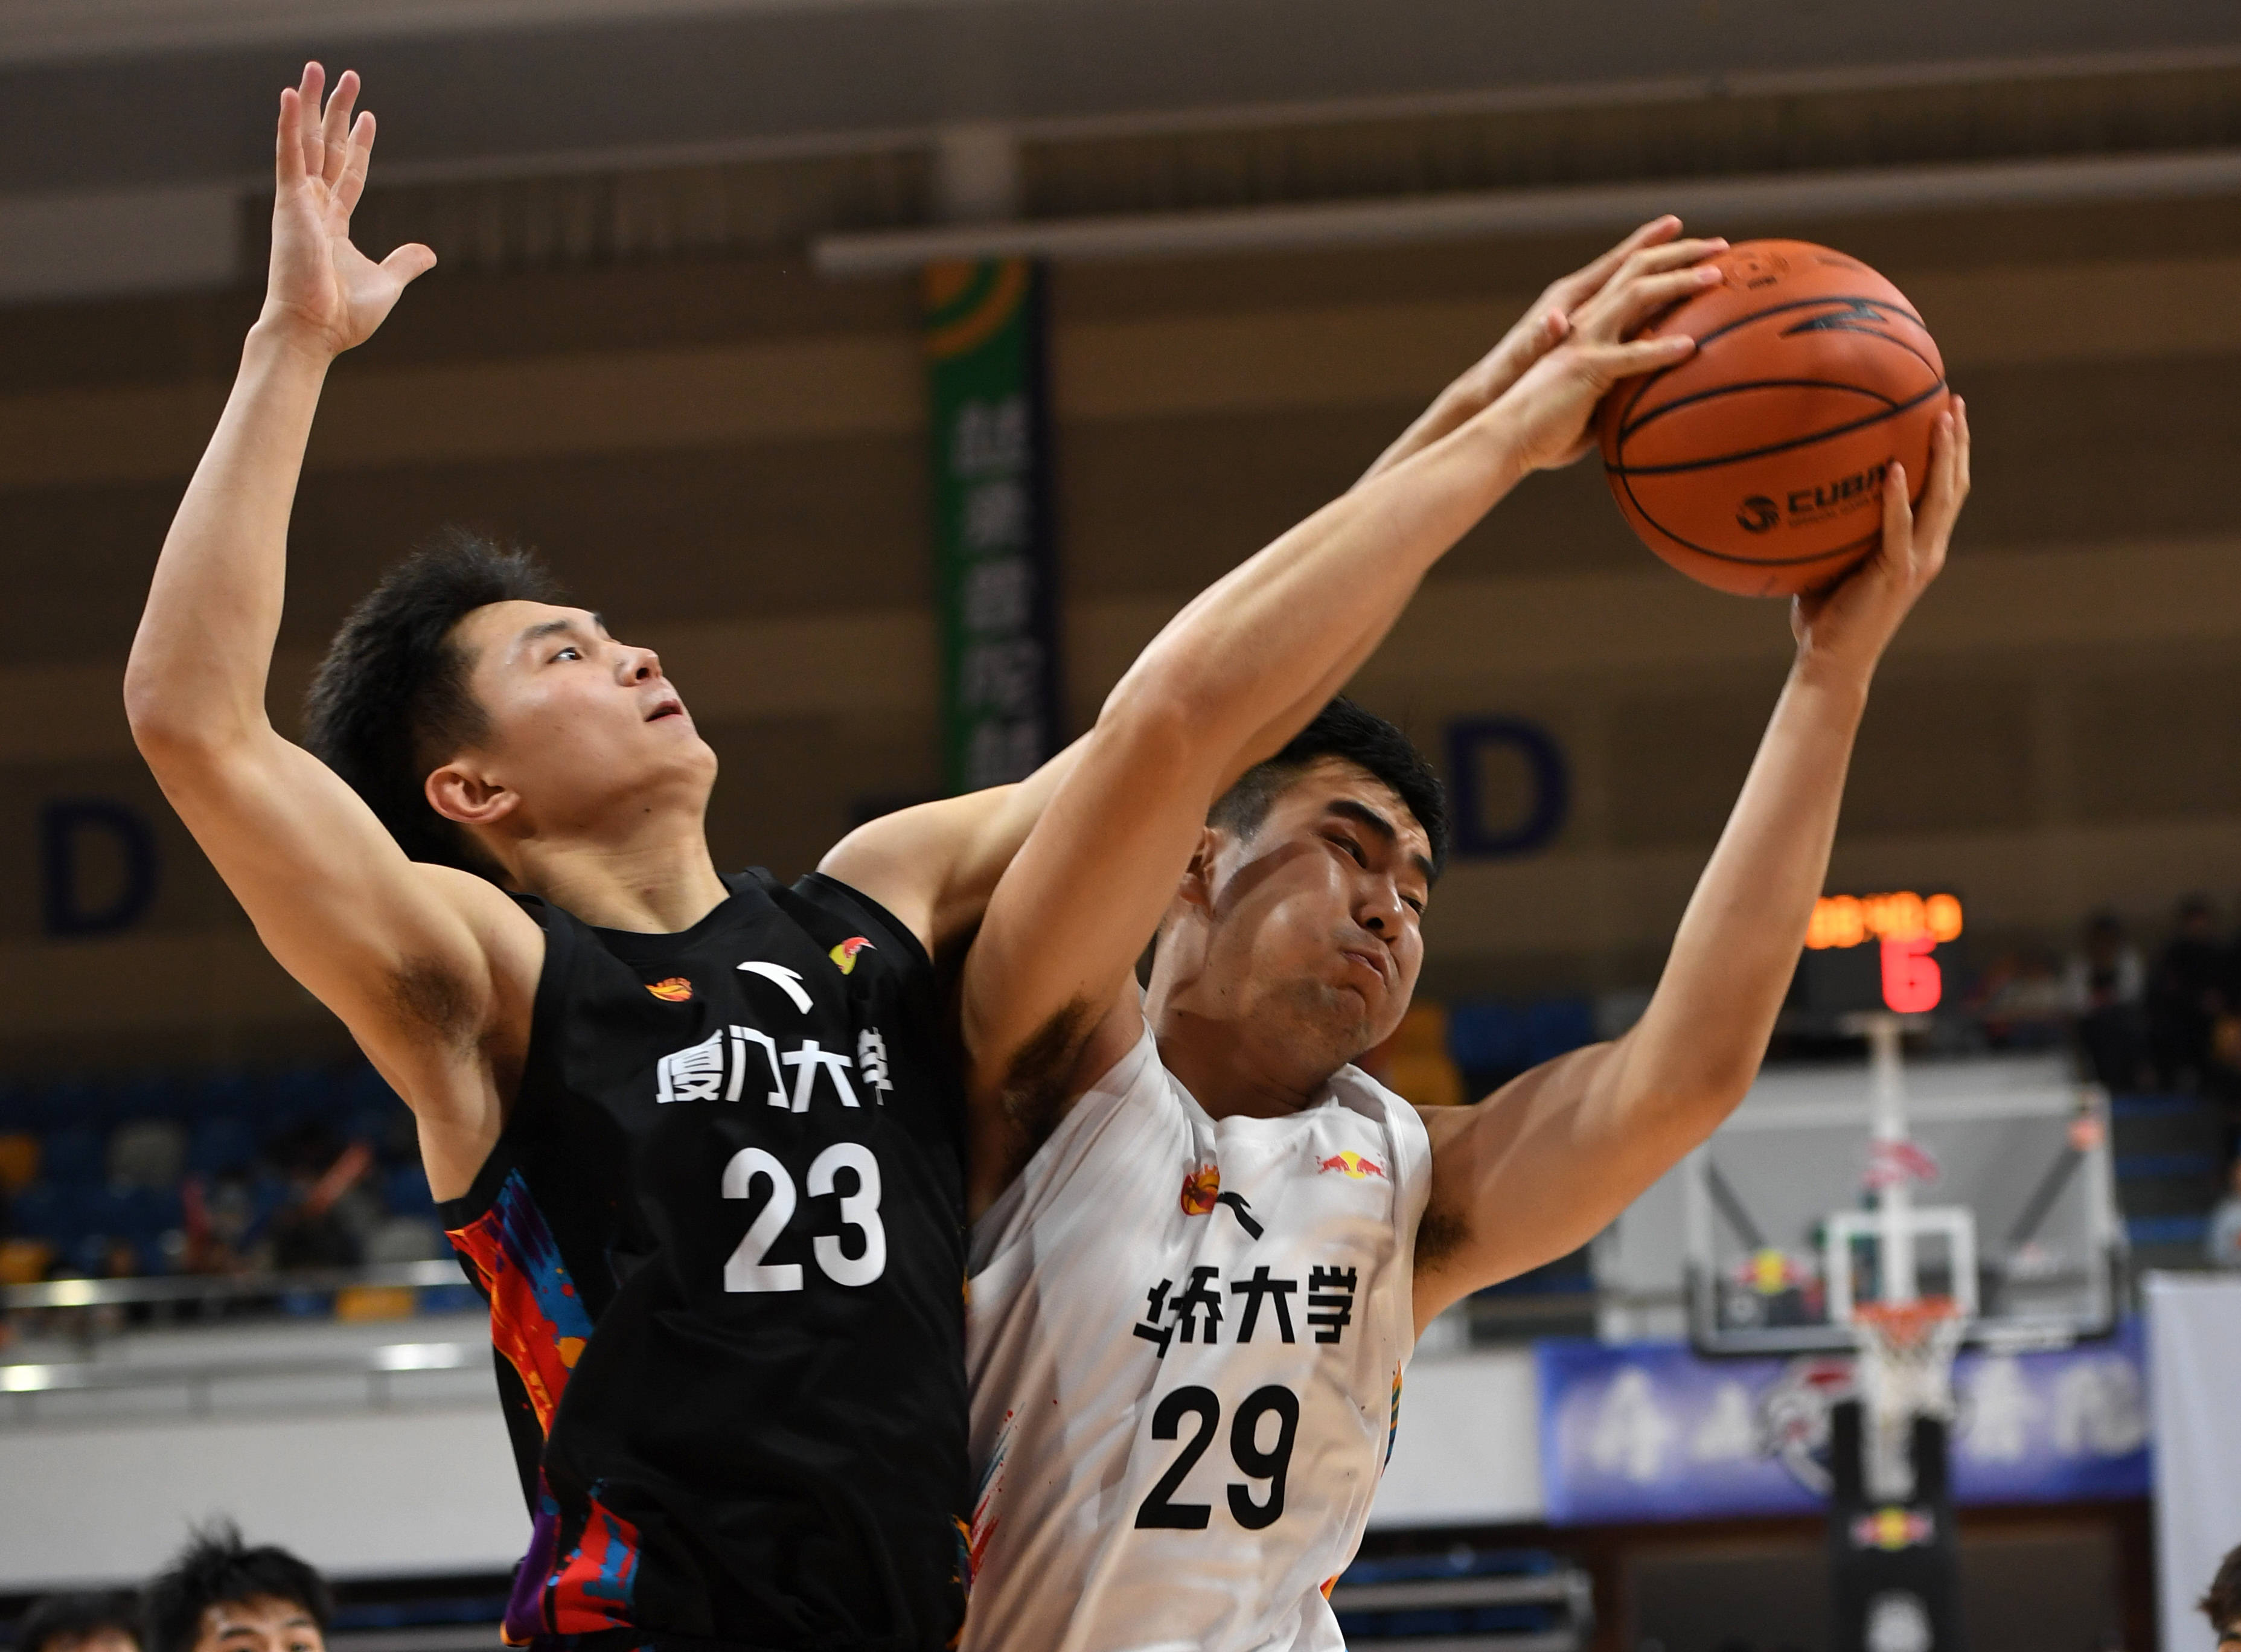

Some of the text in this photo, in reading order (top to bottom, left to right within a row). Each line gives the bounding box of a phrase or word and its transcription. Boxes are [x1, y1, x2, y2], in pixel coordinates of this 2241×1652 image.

[1786, 455, 1896, 513] CUBA
[1448, 715, 1572, 862] D
[40, 798, 158, 942] D
[1881, 933, 1942, 1013] 6
[721, 1142, 887, 1293] 23
[1134, 1385, 1300, 1530] 29
